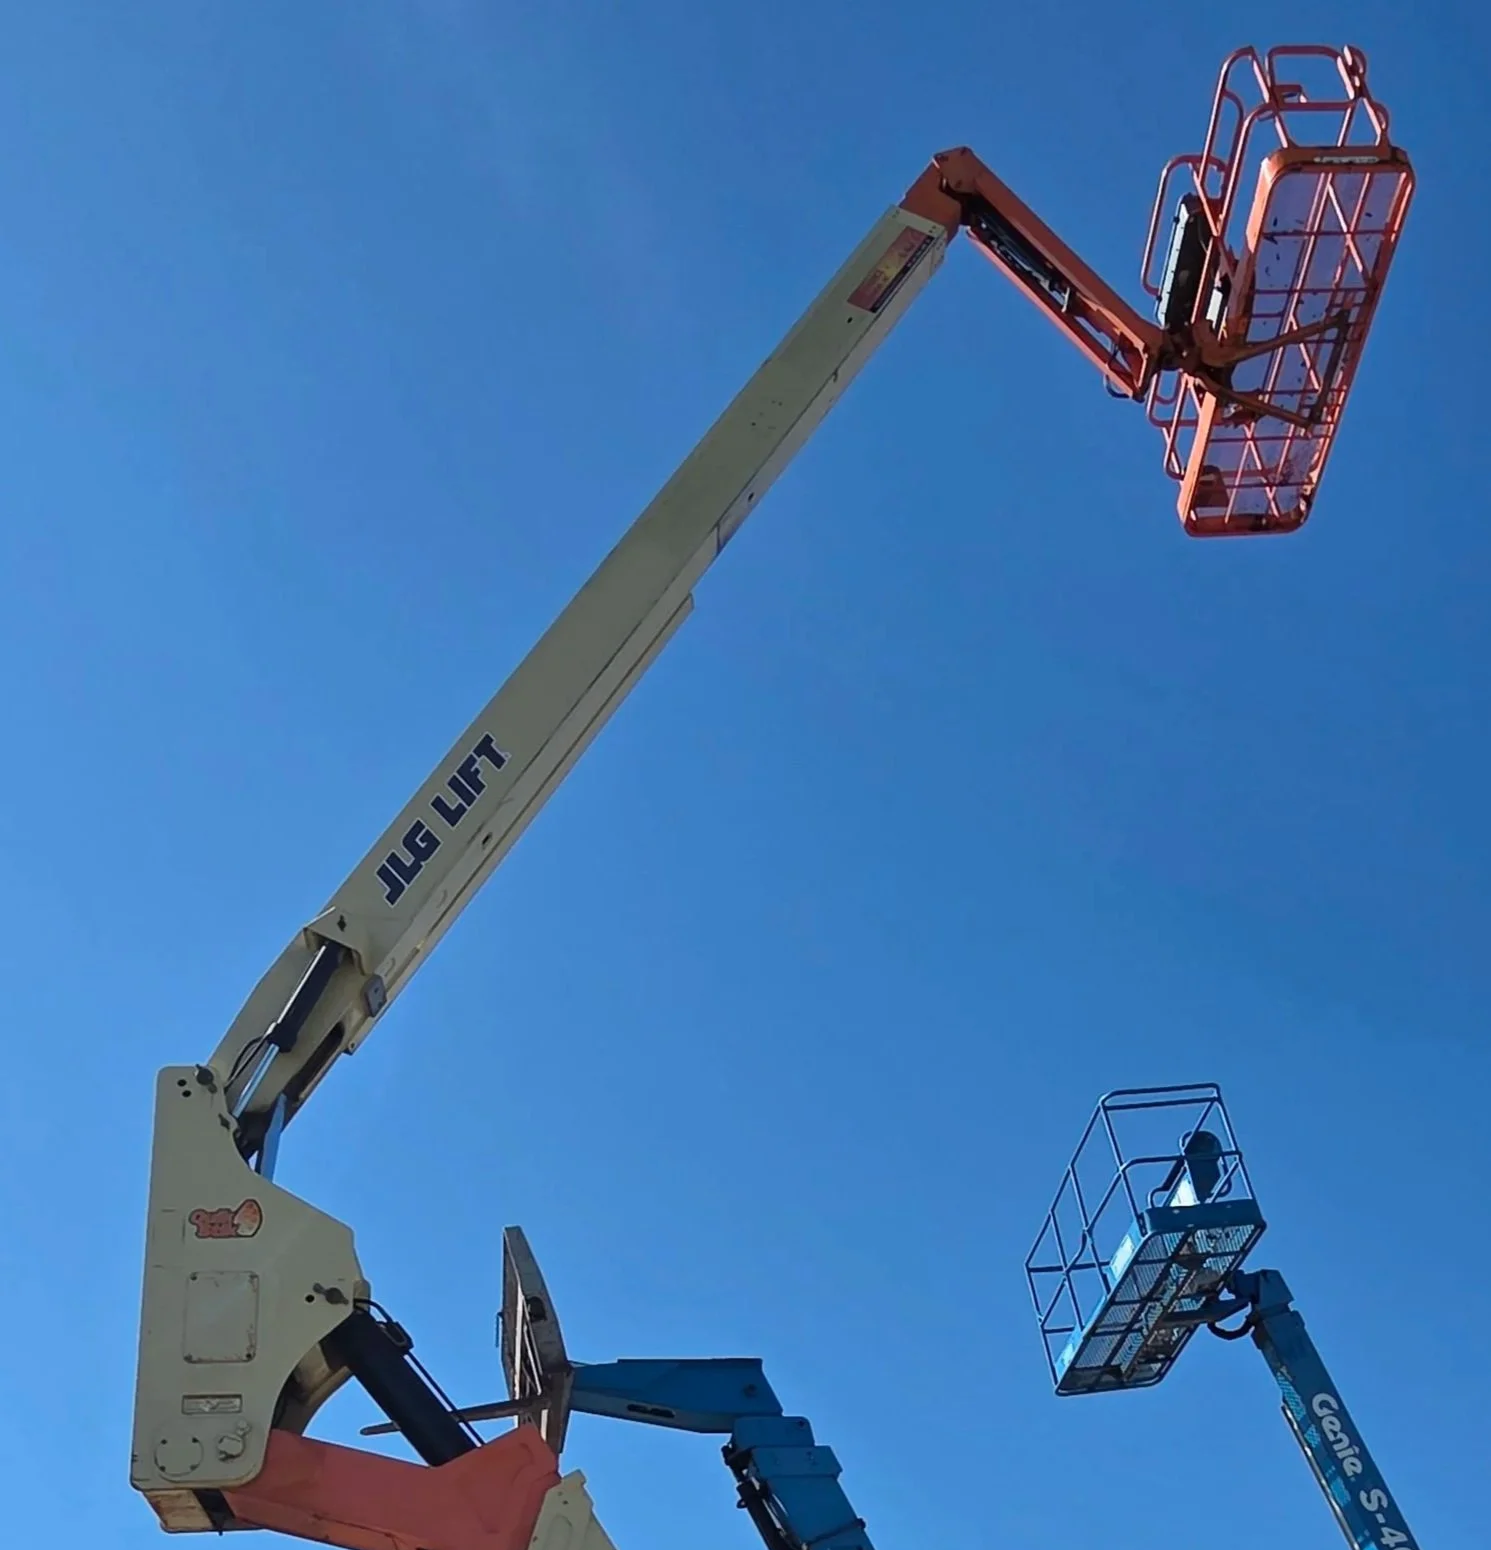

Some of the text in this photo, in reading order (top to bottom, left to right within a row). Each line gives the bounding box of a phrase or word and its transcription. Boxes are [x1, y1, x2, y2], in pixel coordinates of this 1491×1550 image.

[375, 731, 508, 908] JLG LIFT
[1312, 1393, 1363, 1477] Genie
